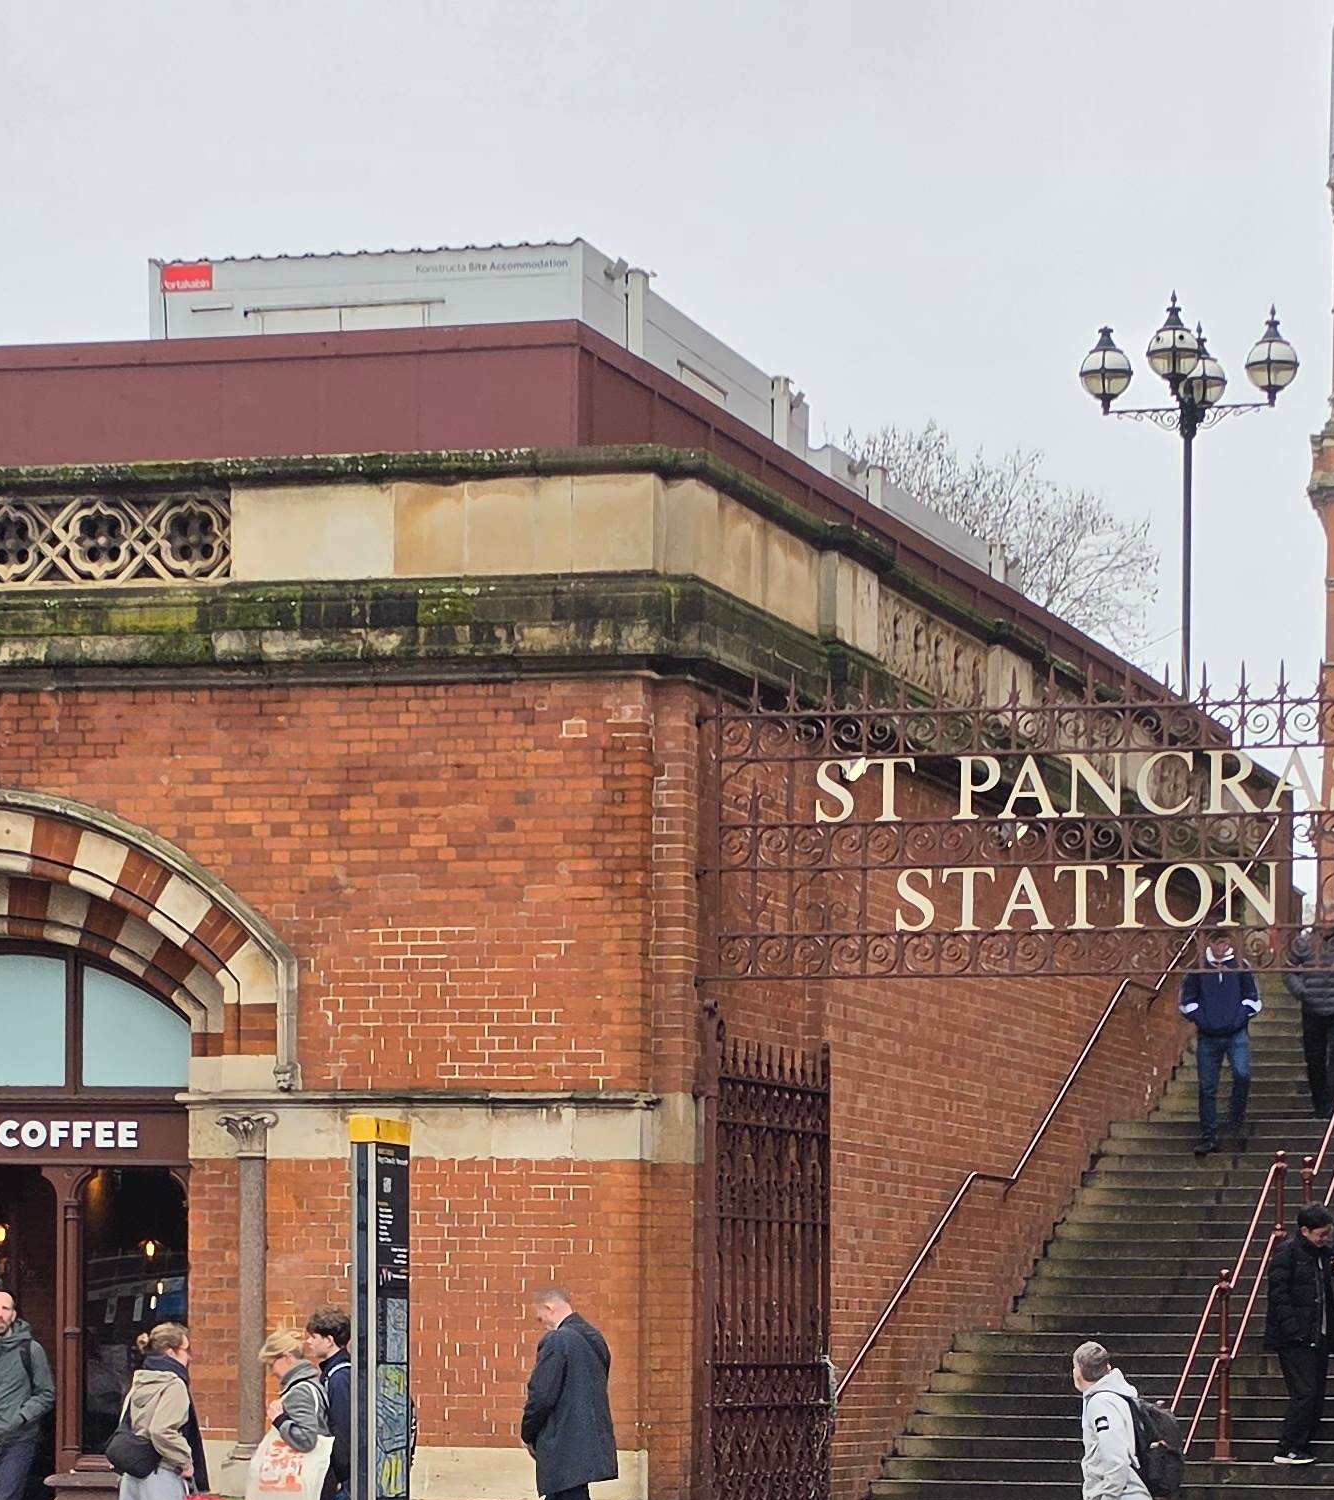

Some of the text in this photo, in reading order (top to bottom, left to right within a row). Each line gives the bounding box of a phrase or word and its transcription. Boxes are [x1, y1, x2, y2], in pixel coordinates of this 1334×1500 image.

[489, 259, 568, 271] Accommodation
[815, 756, 916, 823] ST
[895, 861, 1279, 933] STATION
